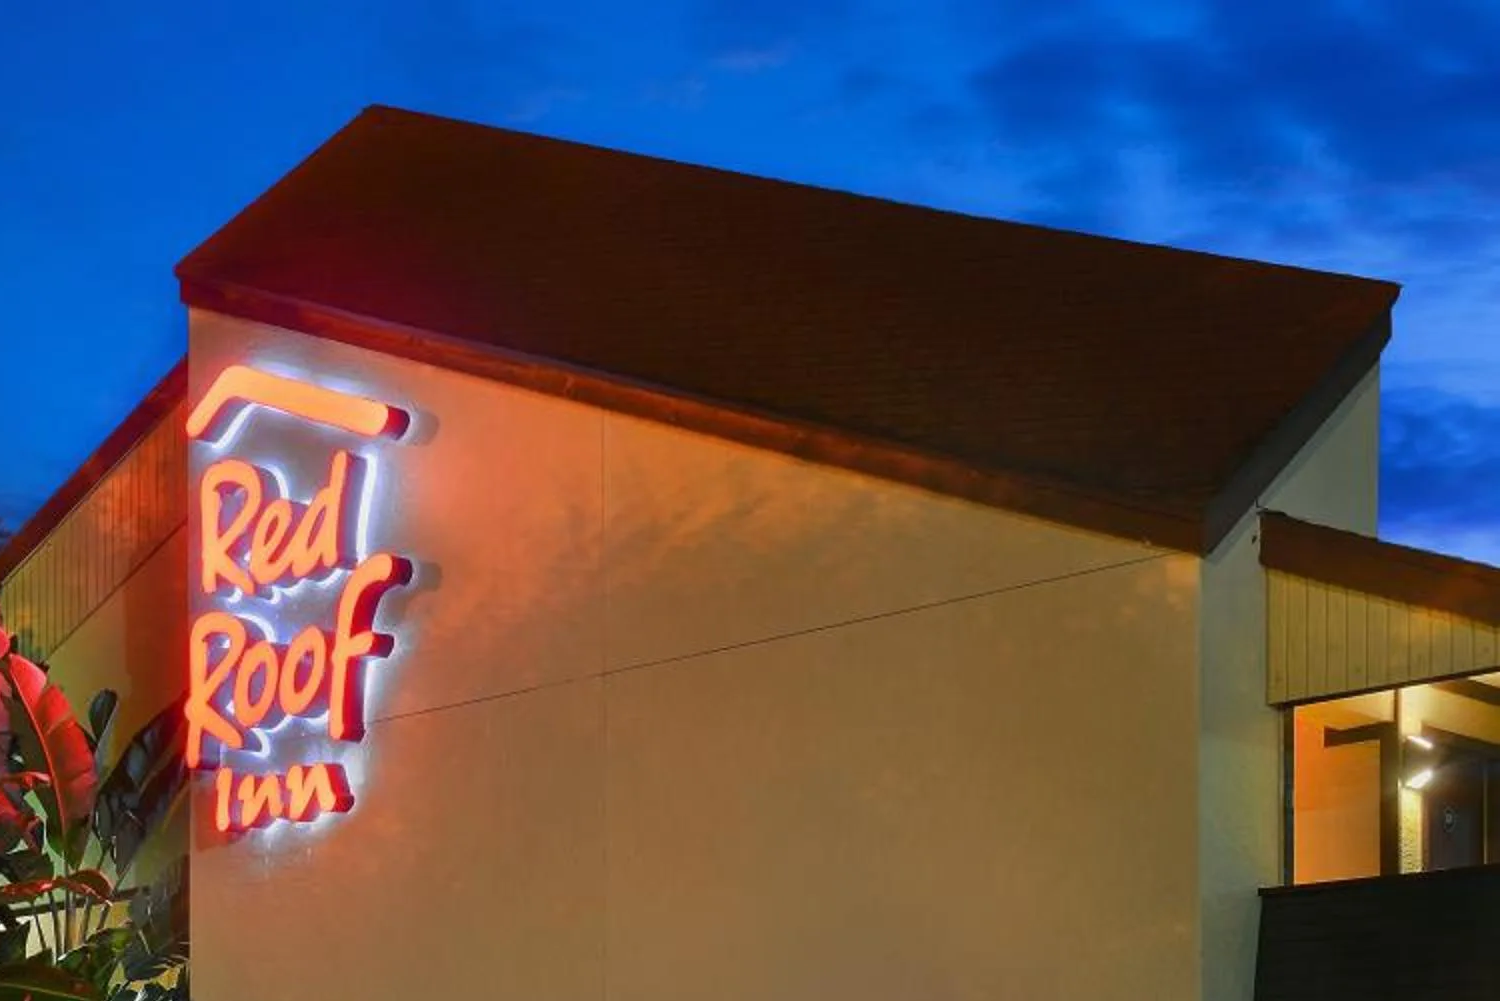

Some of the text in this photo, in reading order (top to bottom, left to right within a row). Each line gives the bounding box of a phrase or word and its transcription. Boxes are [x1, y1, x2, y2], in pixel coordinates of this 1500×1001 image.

[201, 449, 350, 596] Red
[185, 553, 396, 768] Roof
[215, 762, 340, 833] Inn
